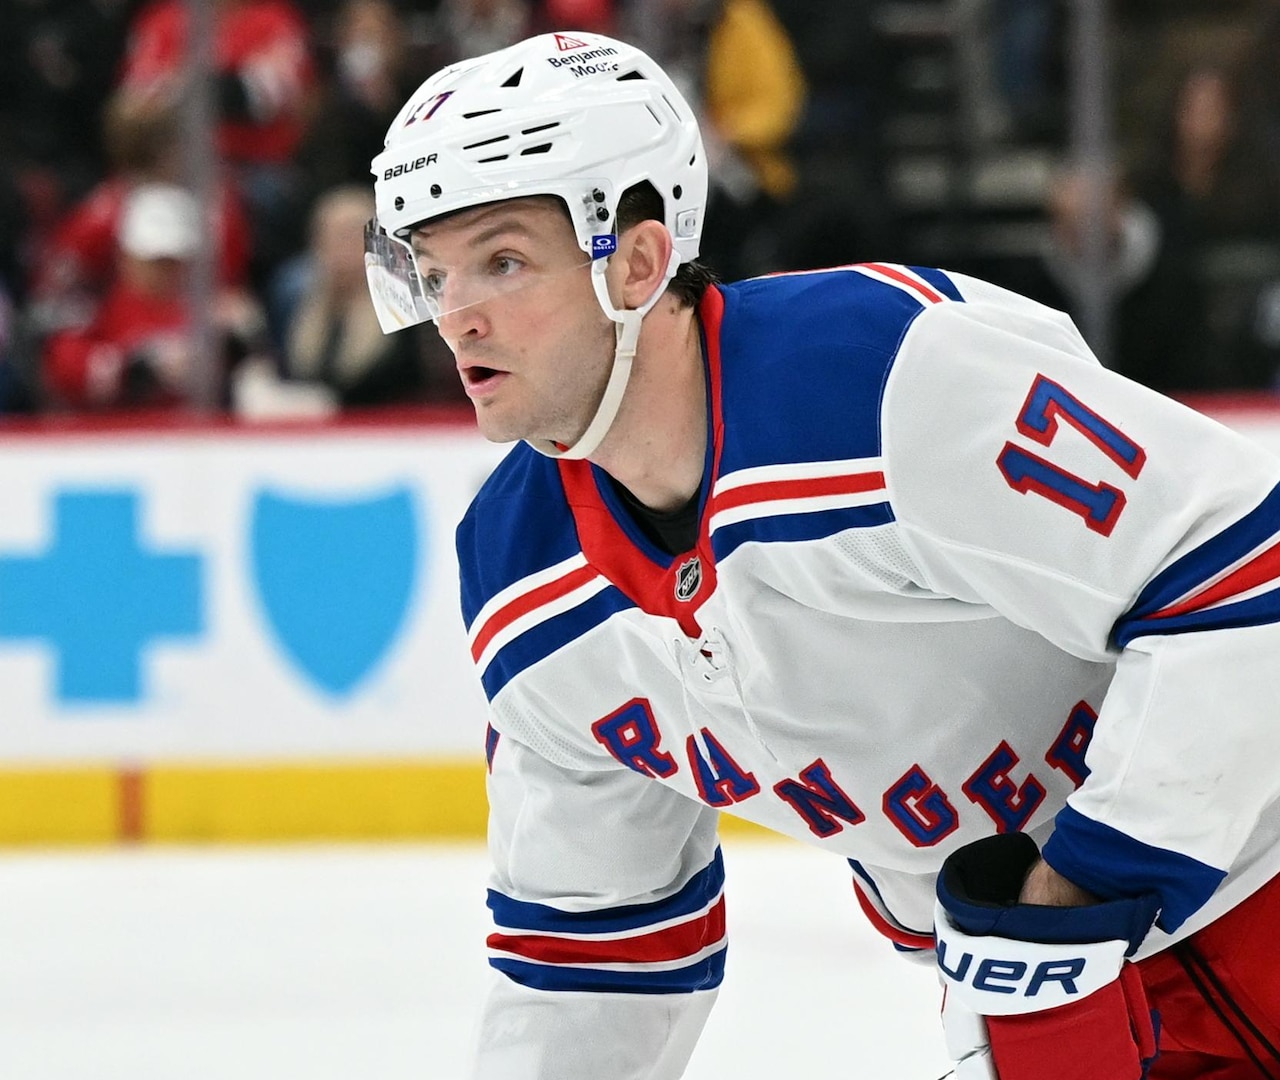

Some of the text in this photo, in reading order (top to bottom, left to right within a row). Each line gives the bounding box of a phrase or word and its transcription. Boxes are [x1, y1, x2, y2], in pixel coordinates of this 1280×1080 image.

[547, 47, 618, 67] Benjamin
[569, 61, 619, 78] Mooe
[384, 153, 438, 181] BAUER
[996, 372, 1148, 538] 17
[591, 697, 1099, 848] RANGER
[937, 939, 1086, 997] UER
